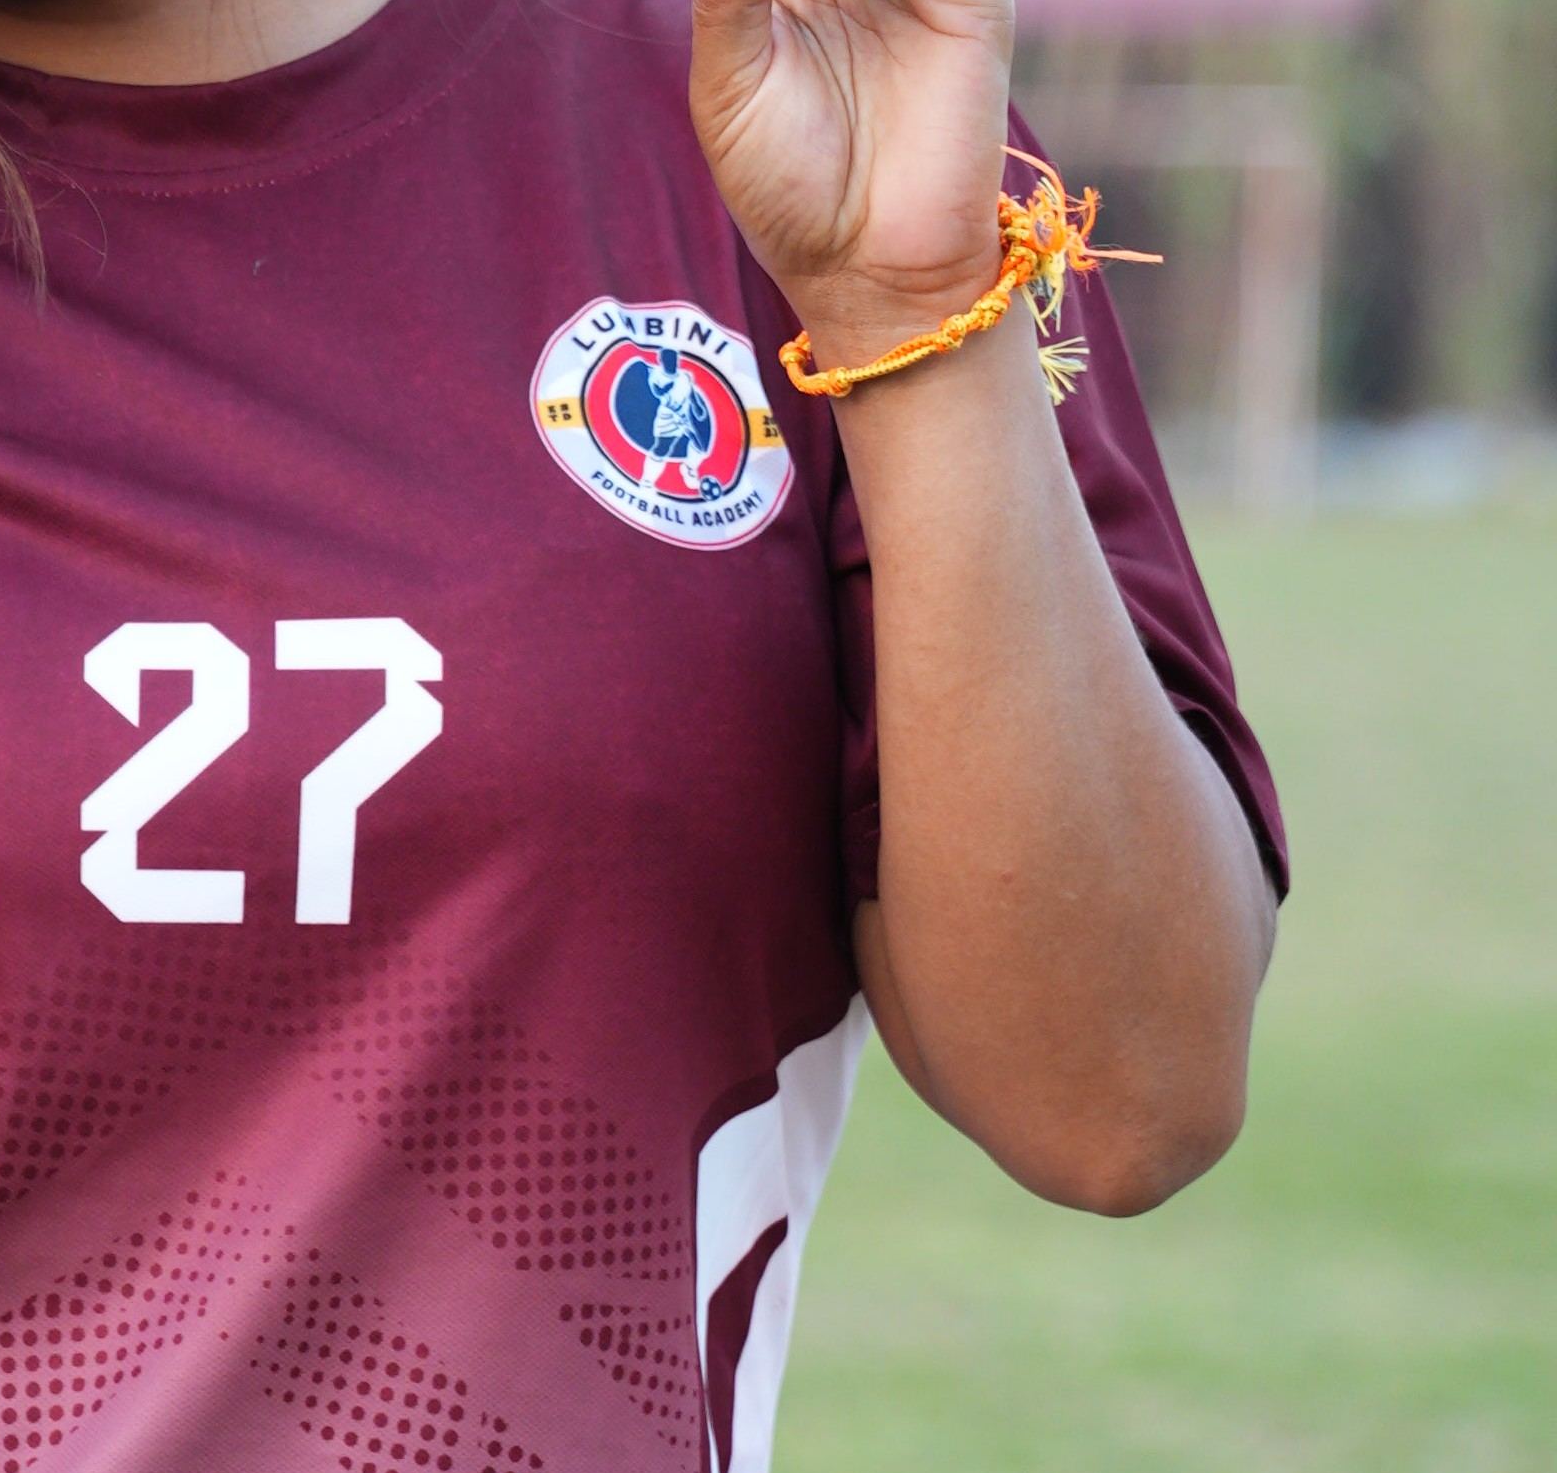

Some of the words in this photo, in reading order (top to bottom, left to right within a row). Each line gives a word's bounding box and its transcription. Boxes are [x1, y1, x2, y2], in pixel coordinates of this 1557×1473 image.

[590, 470, 685, 525] FOOTBALL
[691, 490, 765, 527] ACADEMY
[80, 617, 444, 925] 27
